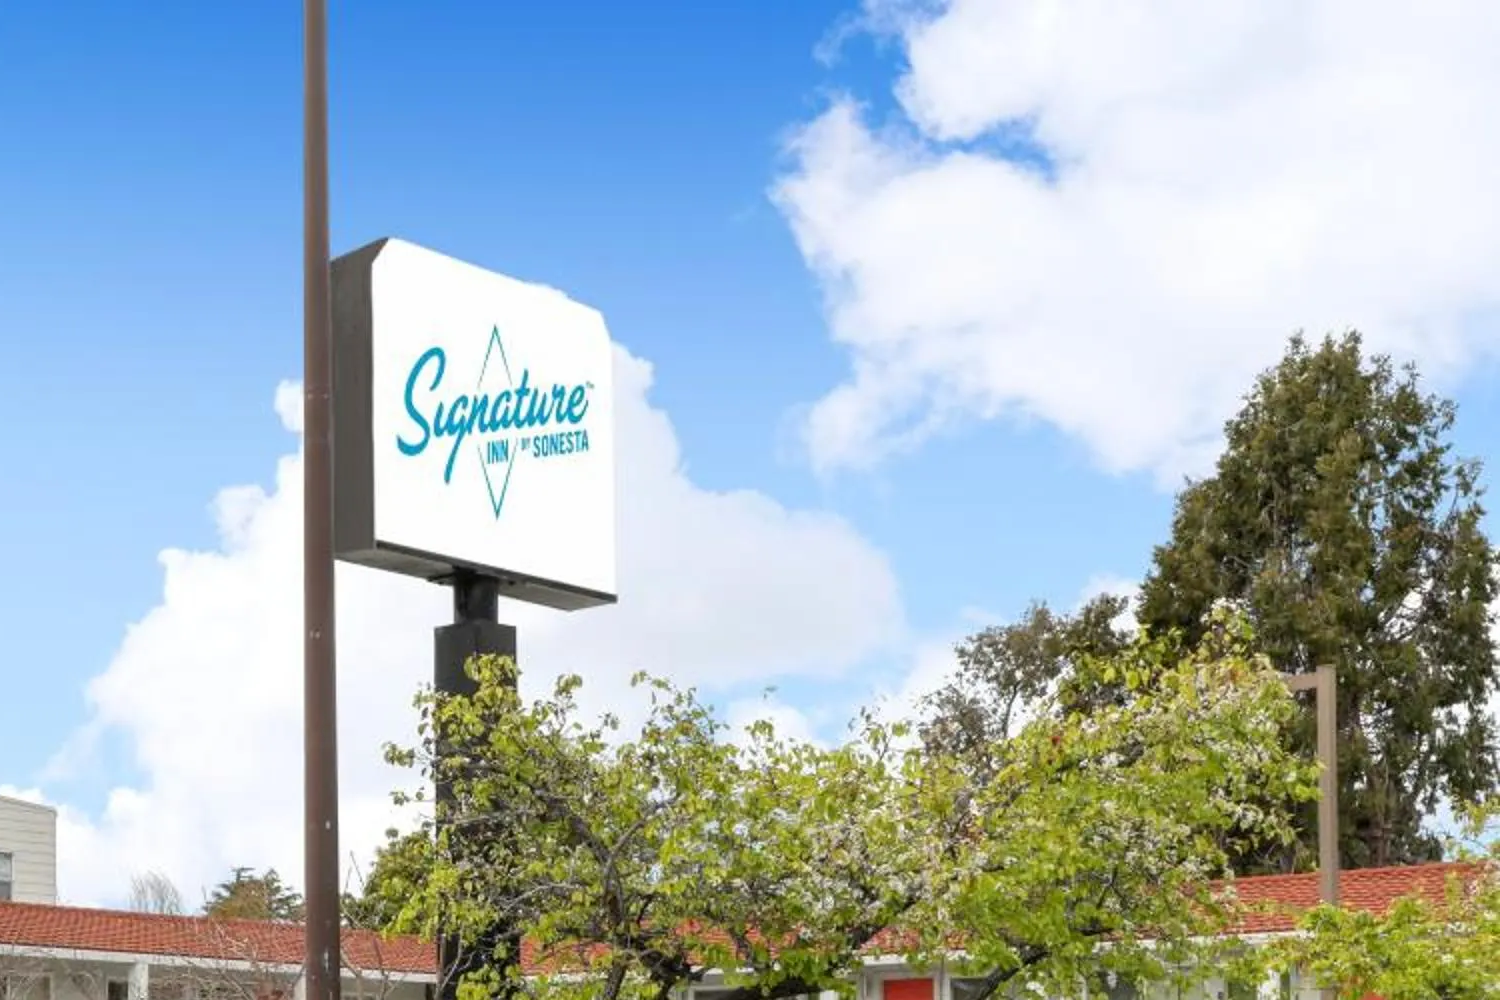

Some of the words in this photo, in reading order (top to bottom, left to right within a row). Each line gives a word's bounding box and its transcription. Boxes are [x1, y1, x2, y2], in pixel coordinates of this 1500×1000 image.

[396, 347, 589, 484] Signature
[487, 439, 509, 464] INN
[533, 429, 589, 458] SONESTA
